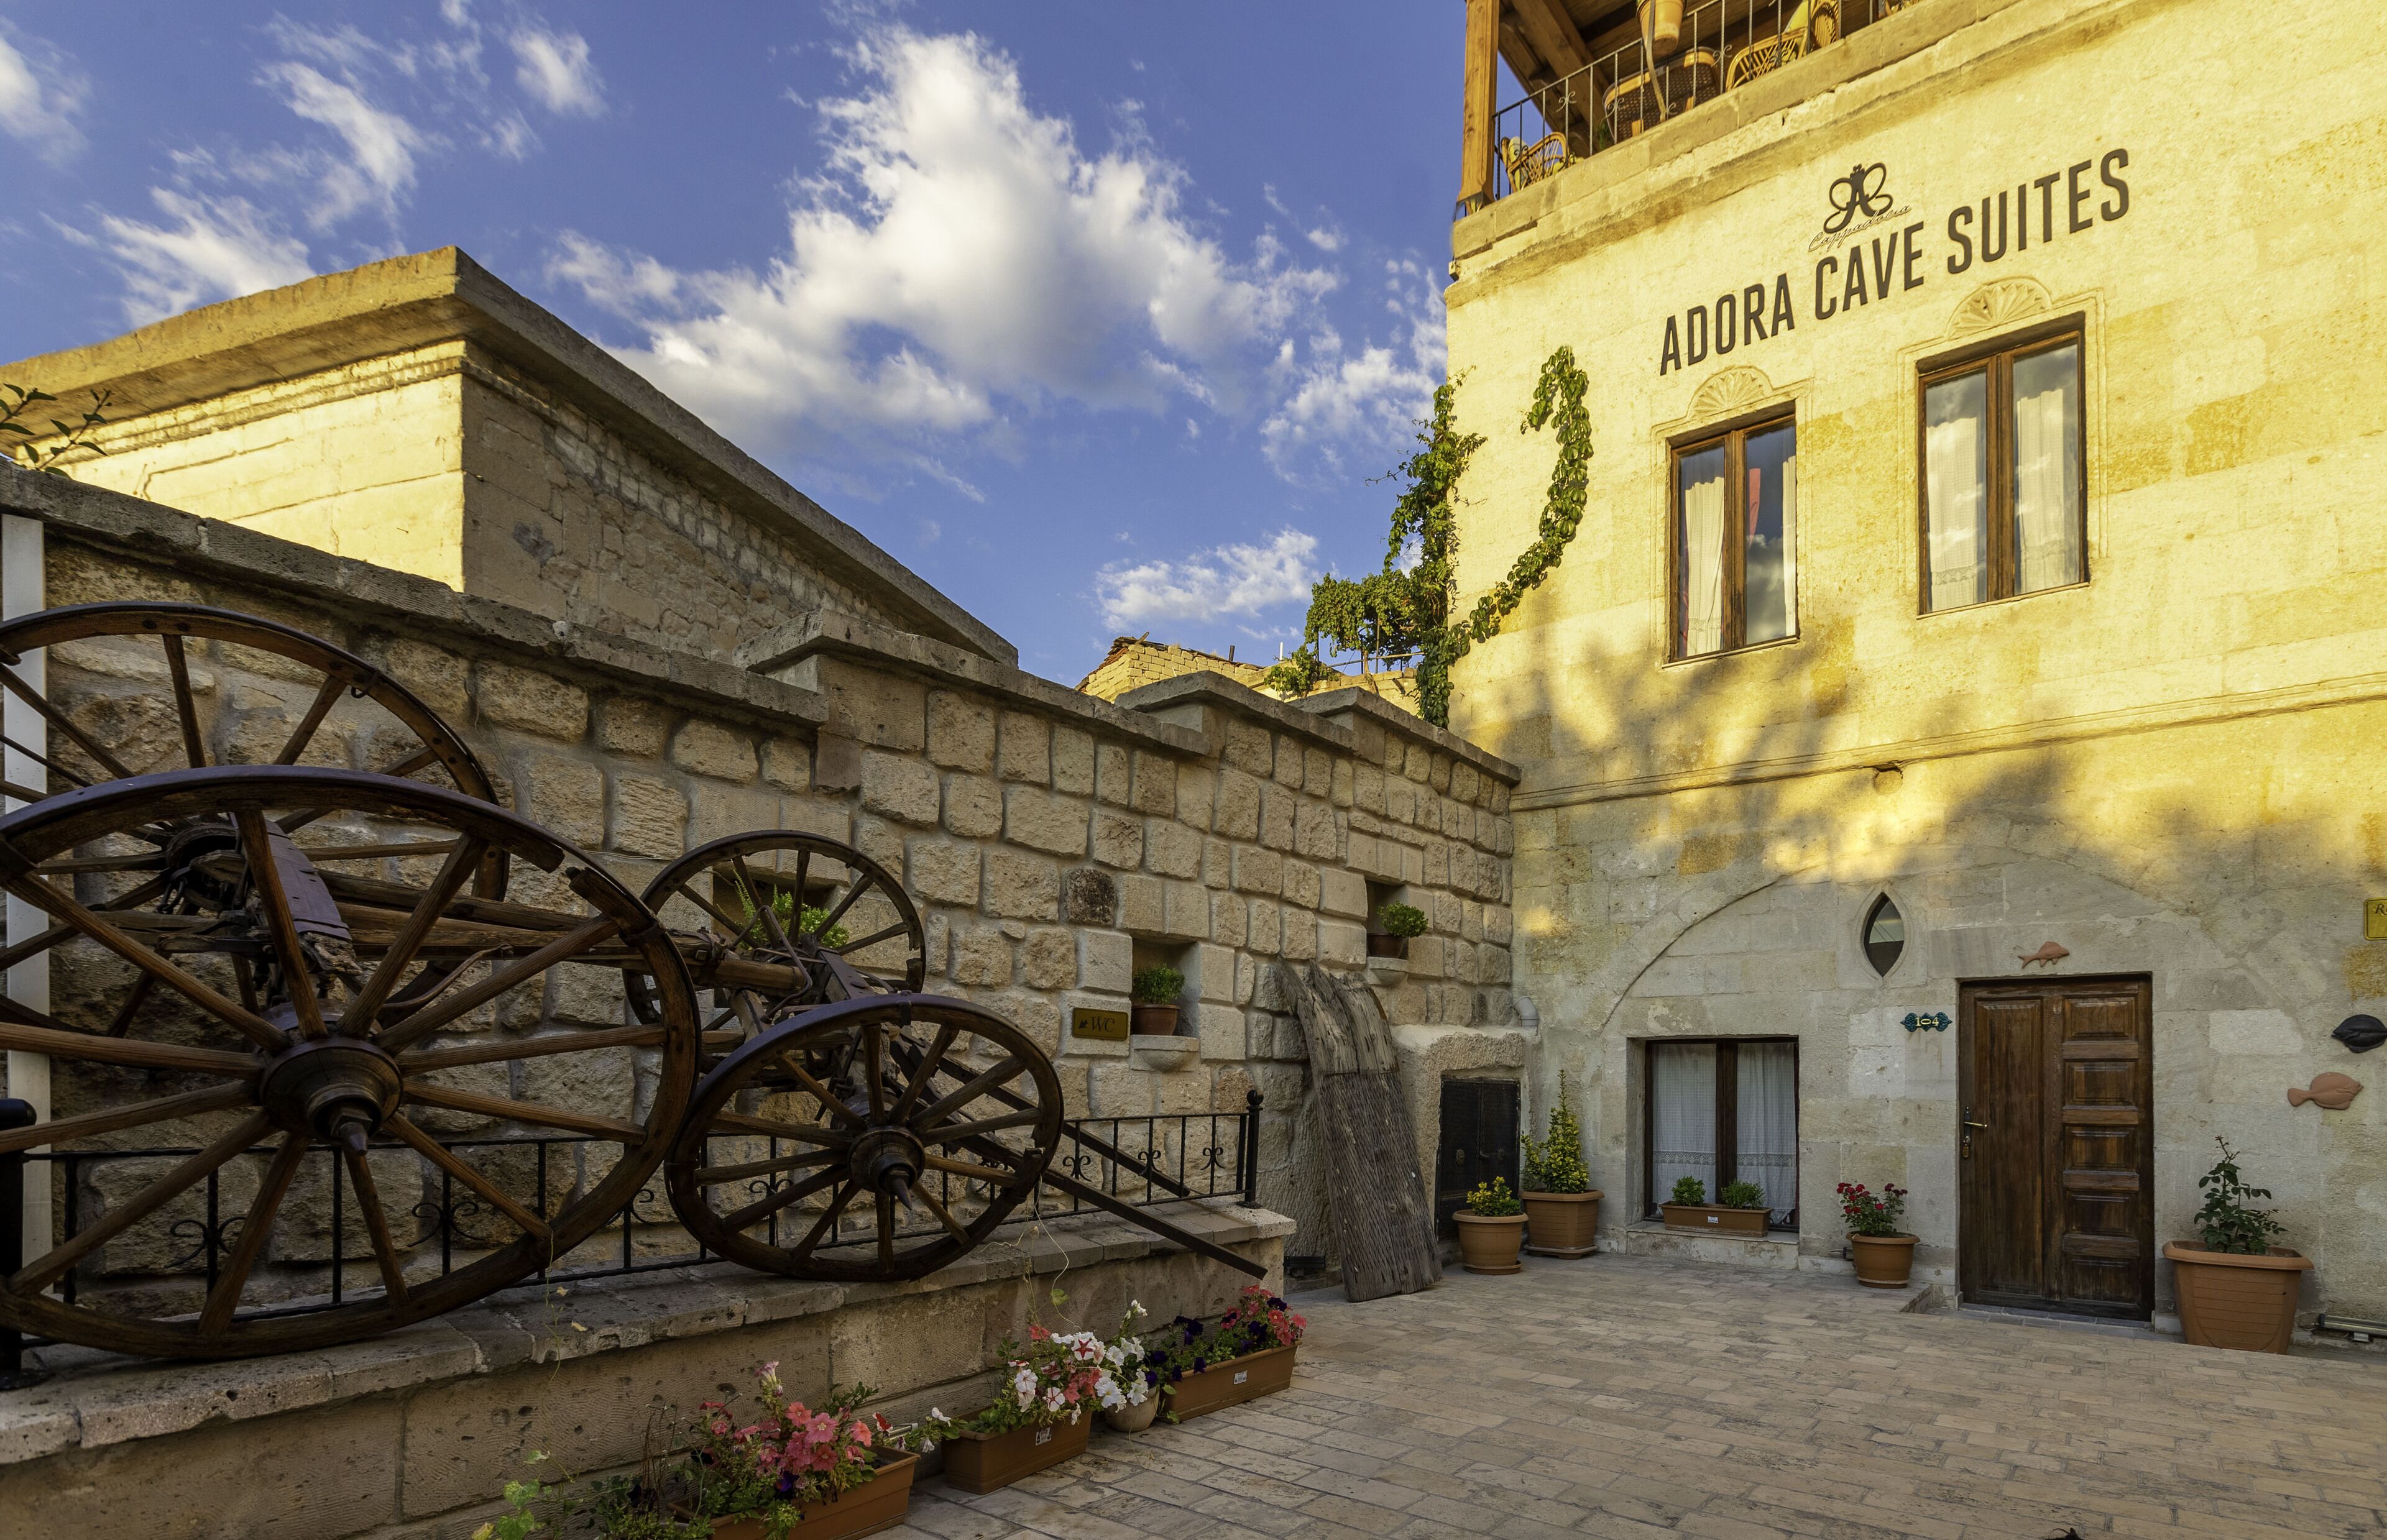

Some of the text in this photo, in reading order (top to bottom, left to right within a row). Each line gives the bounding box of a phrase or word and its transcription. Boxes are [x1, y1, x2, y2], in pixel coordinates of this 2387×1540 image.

[1660, 148, 2130, 375] ADORA CAVE SUITES
[1091, 1016, 1115, 1032] WC
[1915, 1017, 1939, 1026] 104
